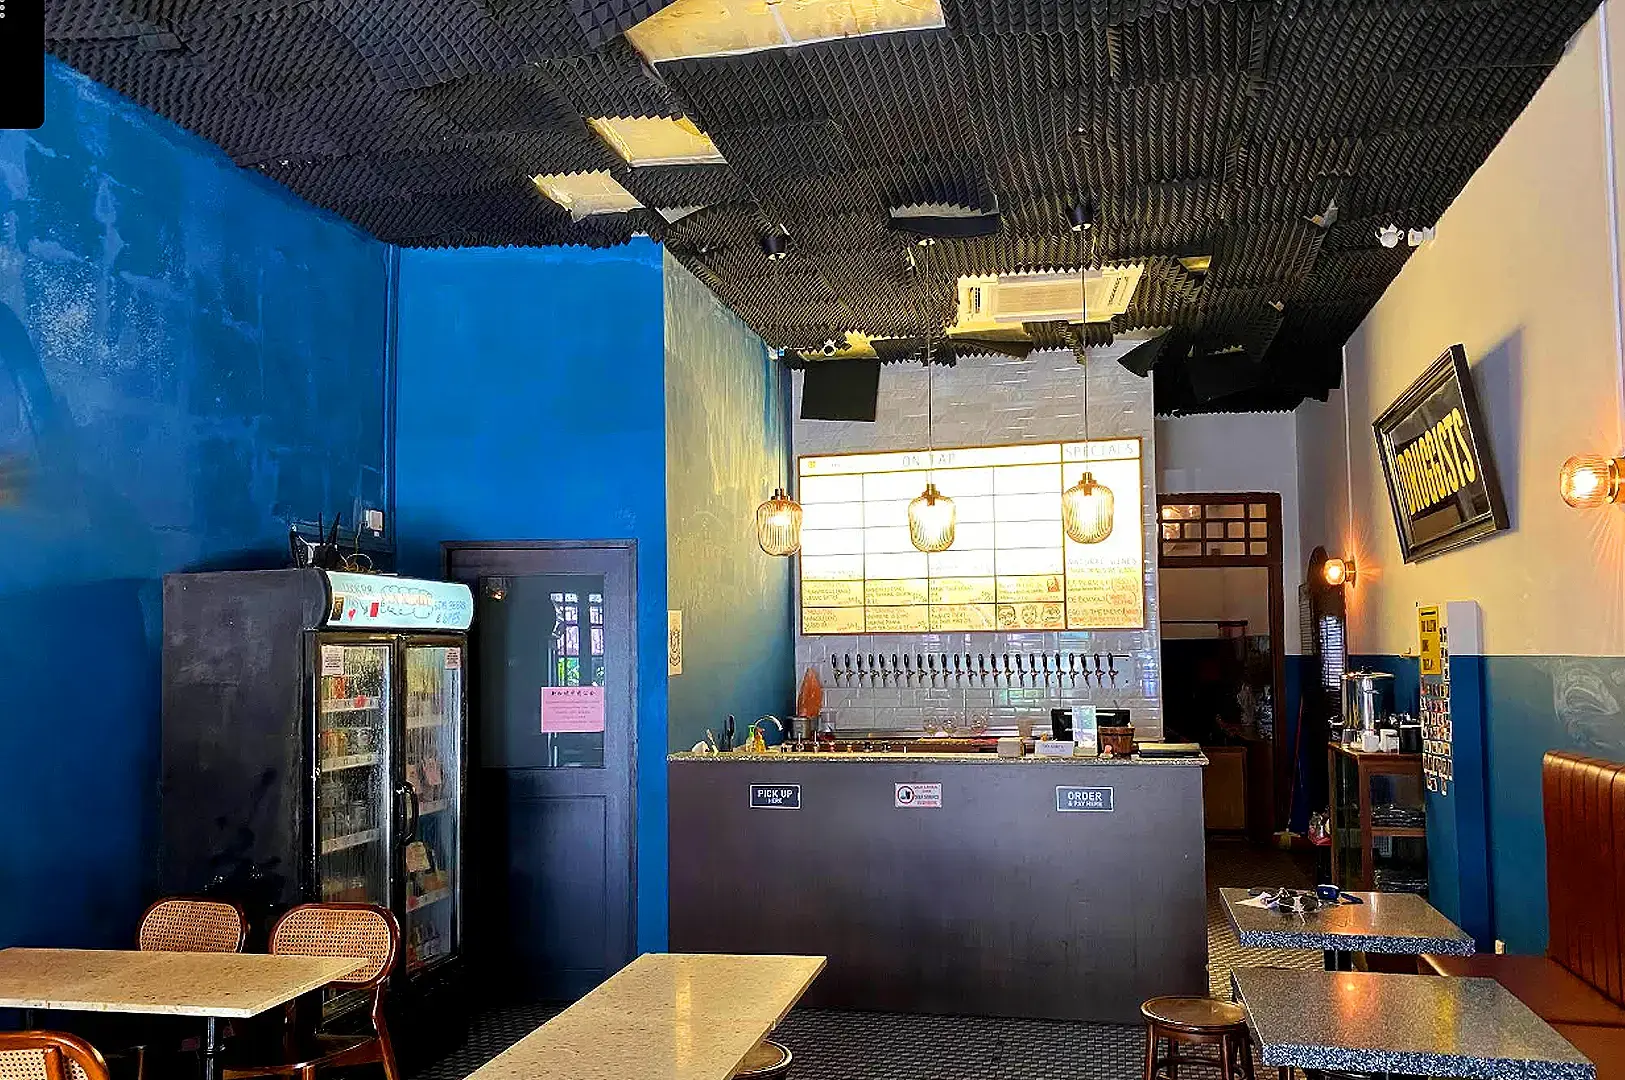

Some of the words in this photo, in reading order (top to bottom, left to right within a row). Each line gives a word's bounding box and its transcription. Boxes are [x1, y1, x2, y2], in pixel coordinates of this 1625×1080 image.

[902, 454, 920, 468] ON
[757, 789, 779, 798] PICK
[780, 789, 793, 798] UP
[1067, 790, 1103, 801] ORDER
